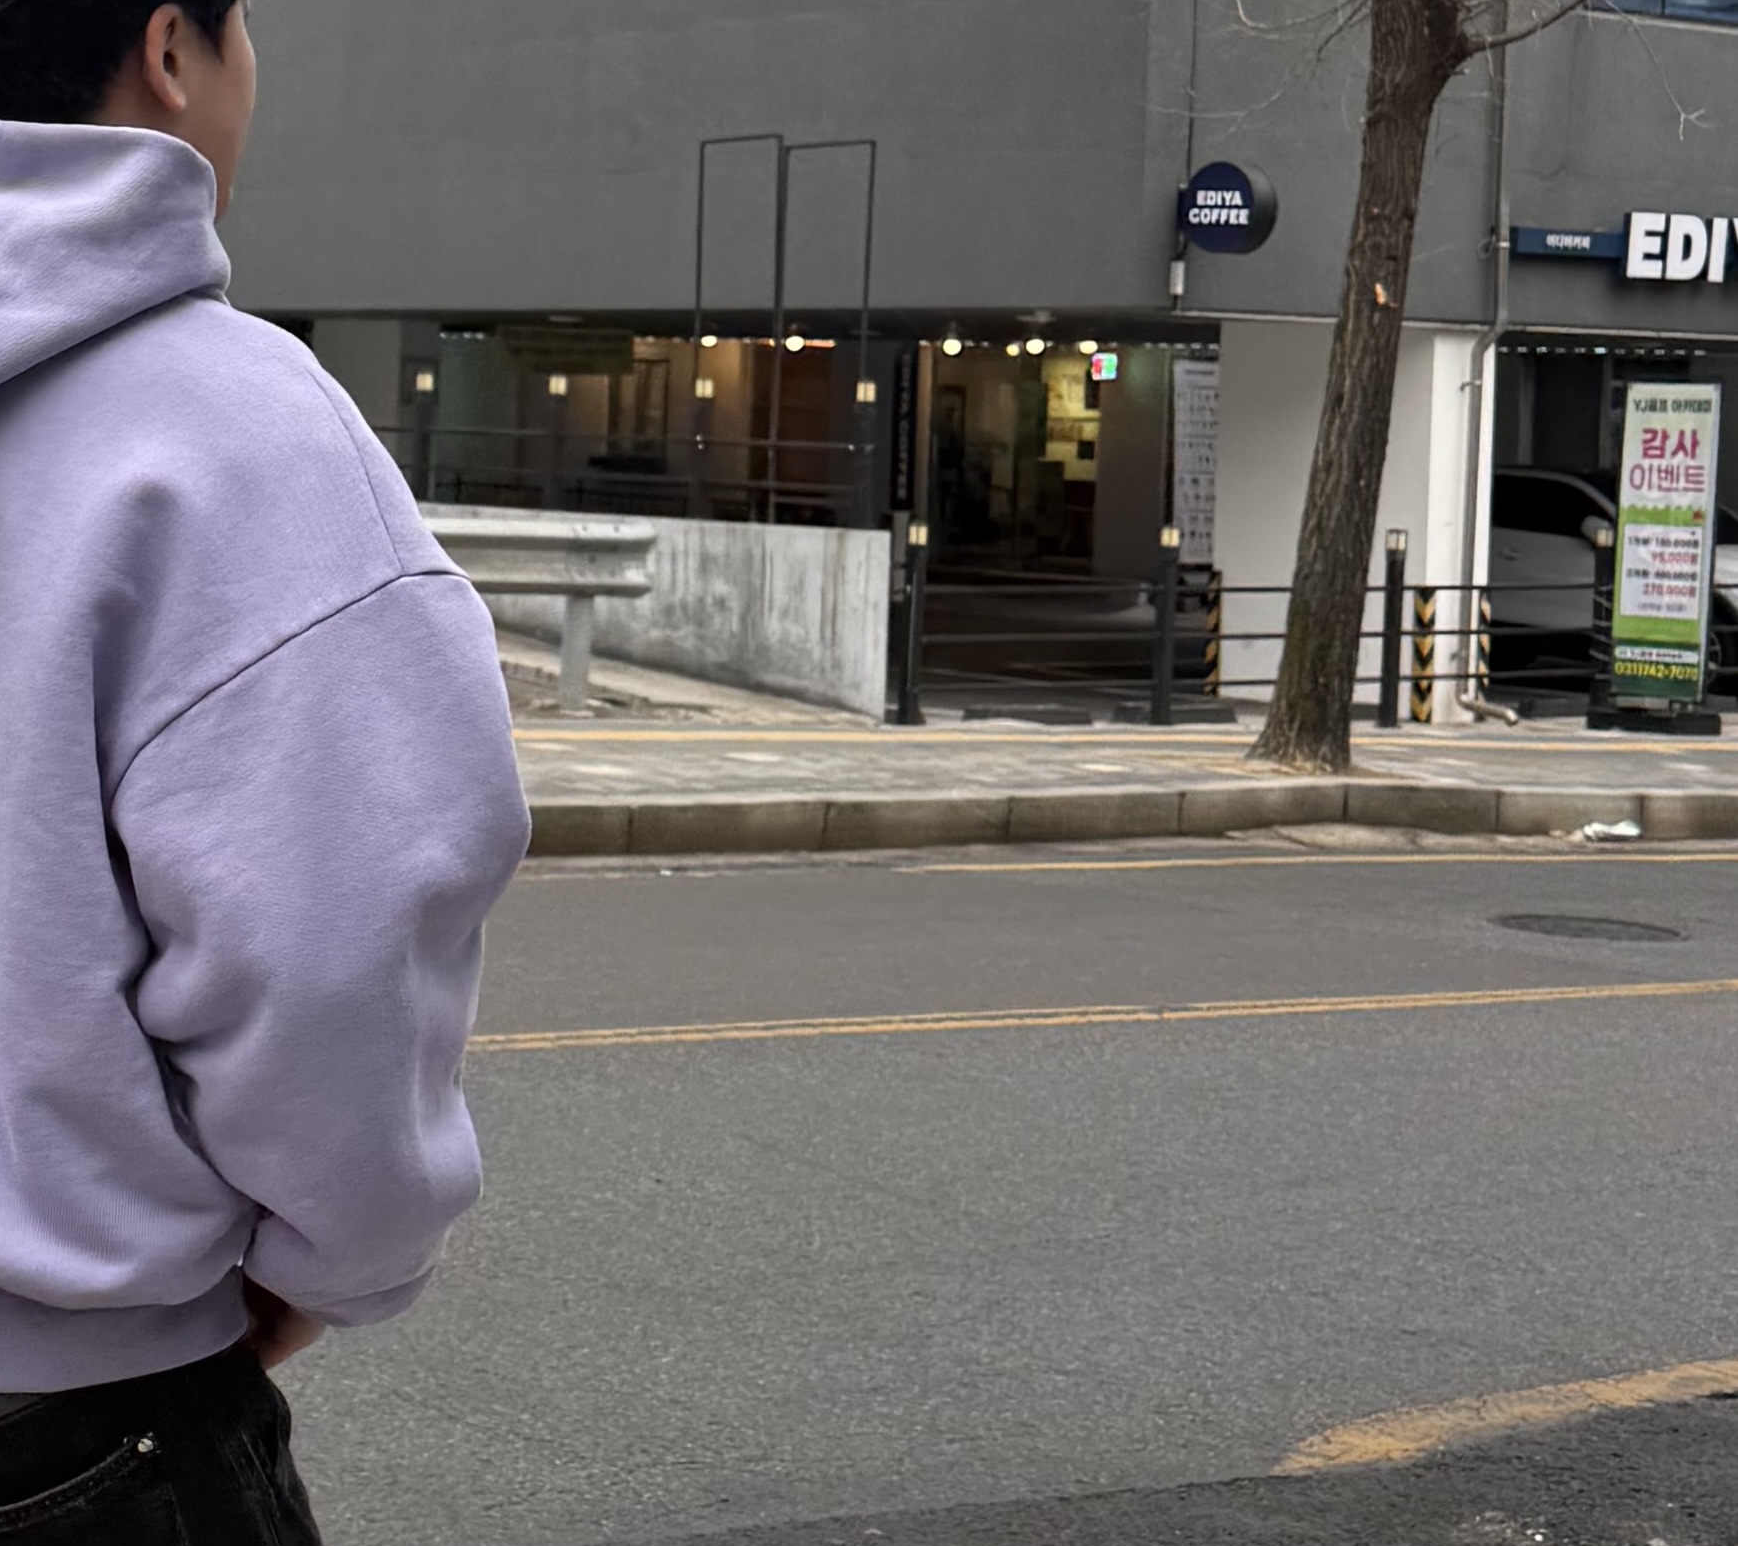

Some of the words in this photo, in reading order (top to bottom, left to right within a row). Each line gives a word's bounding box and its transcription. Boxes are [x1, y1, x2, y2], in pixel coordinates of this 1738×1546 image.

[1196, 189, 1244, 206] EDIYA
[1188, 207, 1250, 225] COFFEE
[1626, 211, 1738, 284] EDI
[1641, 427, 1700, 460] 감사
[1629, 463, 1705, 493] 이벤트
